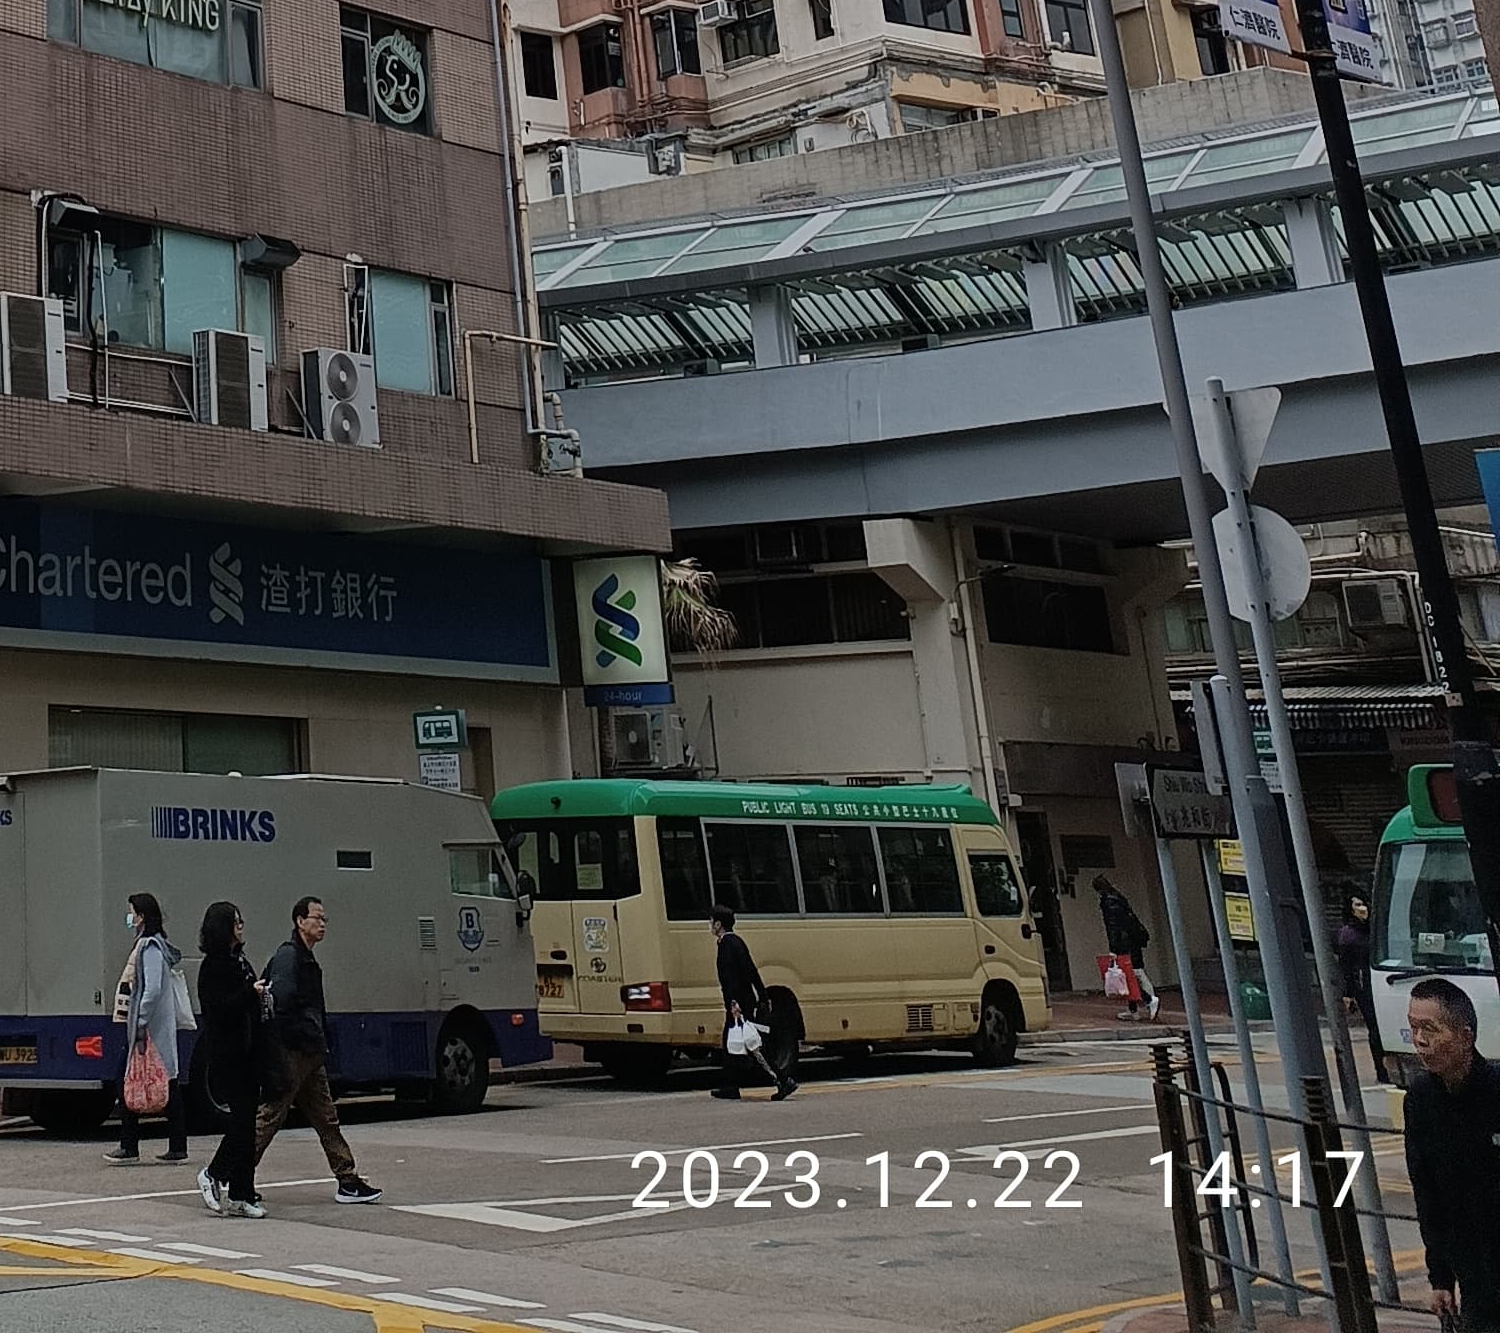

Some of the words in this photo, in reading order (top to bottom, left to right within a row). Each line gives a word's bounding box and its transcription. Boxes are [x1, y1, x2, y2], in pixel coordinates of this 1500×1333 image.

[1229, 4, 1281, 41] 仁濟醫院
[259, 562, 398, 623] 渣打銀行
[742, 800, 770, 814] PUBLIC
[774, 801, 797, 814] LIGHT
[801, 802, 817, 815] BUS
[834, 803, 859, 816] SEATS
[164, 805, 276, 843] BRINKS
[465, 912, 475, 929] B
[538, 985, 562, 996] 8727
